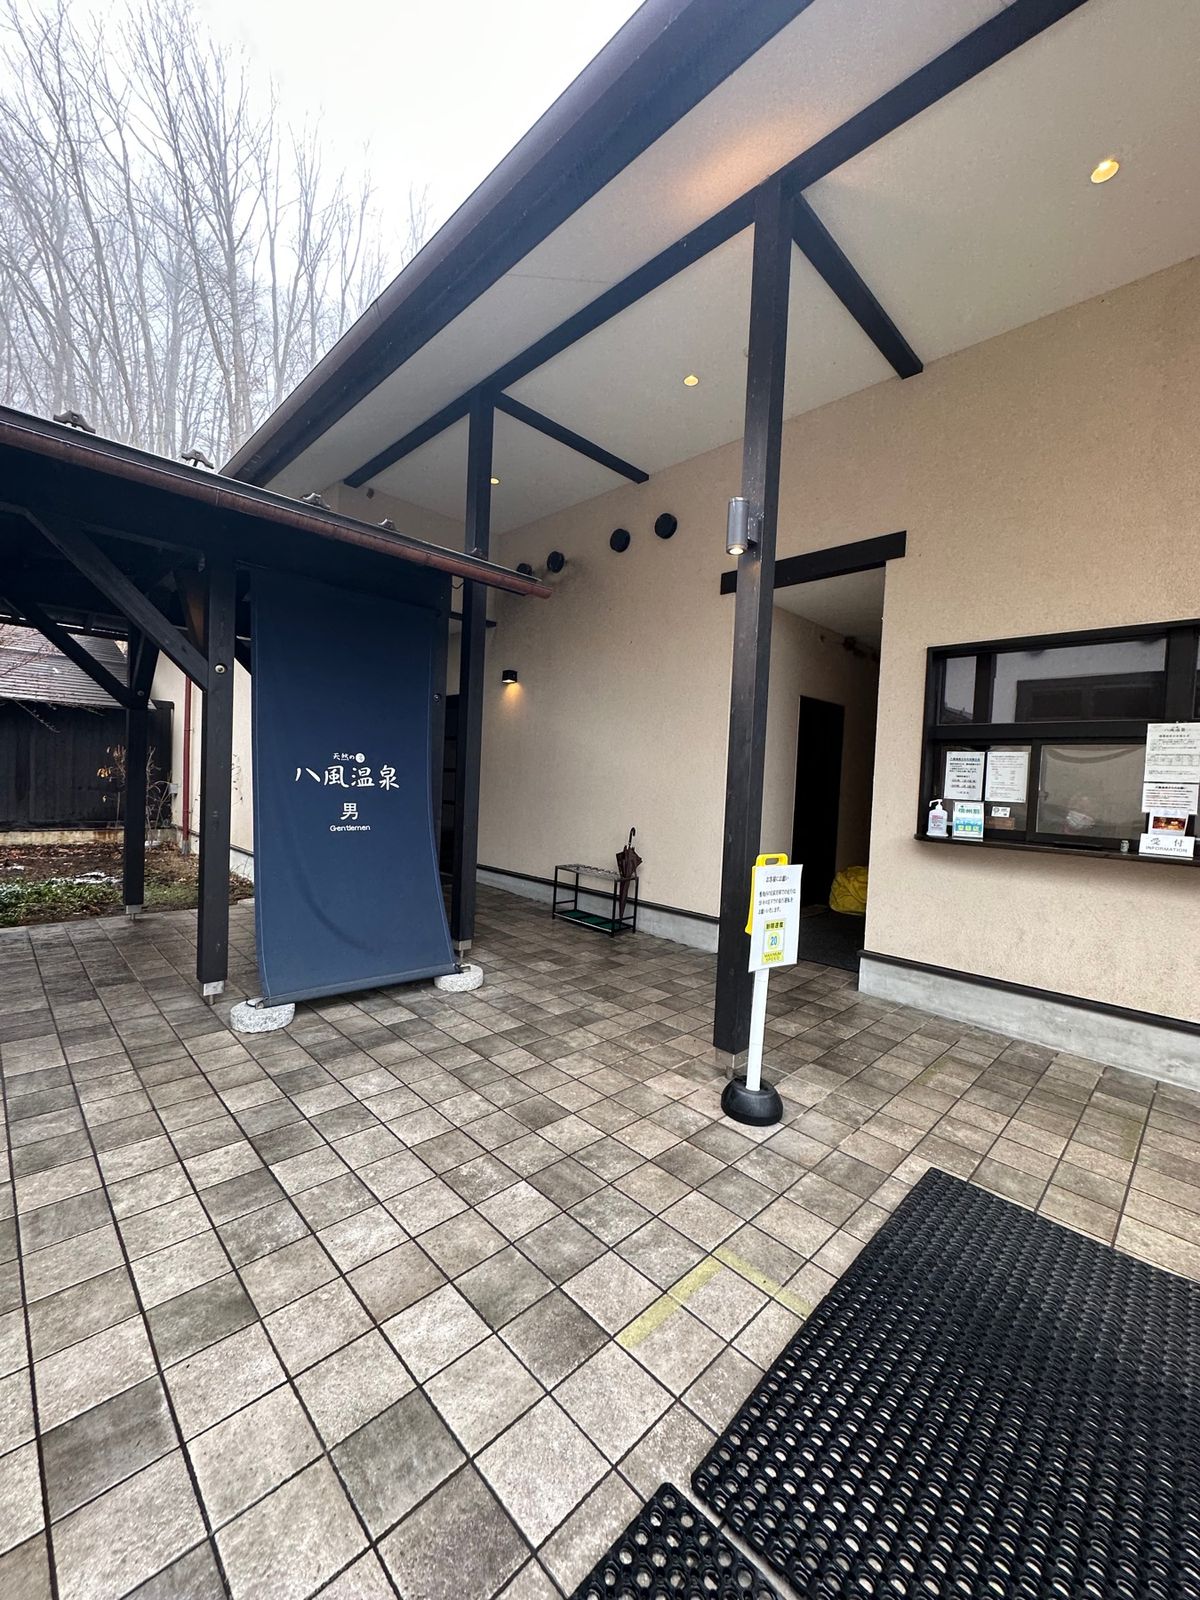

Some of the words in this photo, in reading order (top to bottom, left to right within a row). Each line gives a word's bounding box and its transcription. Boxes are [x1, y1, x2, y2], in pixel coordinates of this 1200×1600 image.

[295, 764, 399, 791] 八風温泉
[340, 802, 358, 820] 男
[329, 824, 371, 832] Gentlemen
[1145, 845, 1188, 853] INFORMATION
[770, 935, 778, 946] 20
